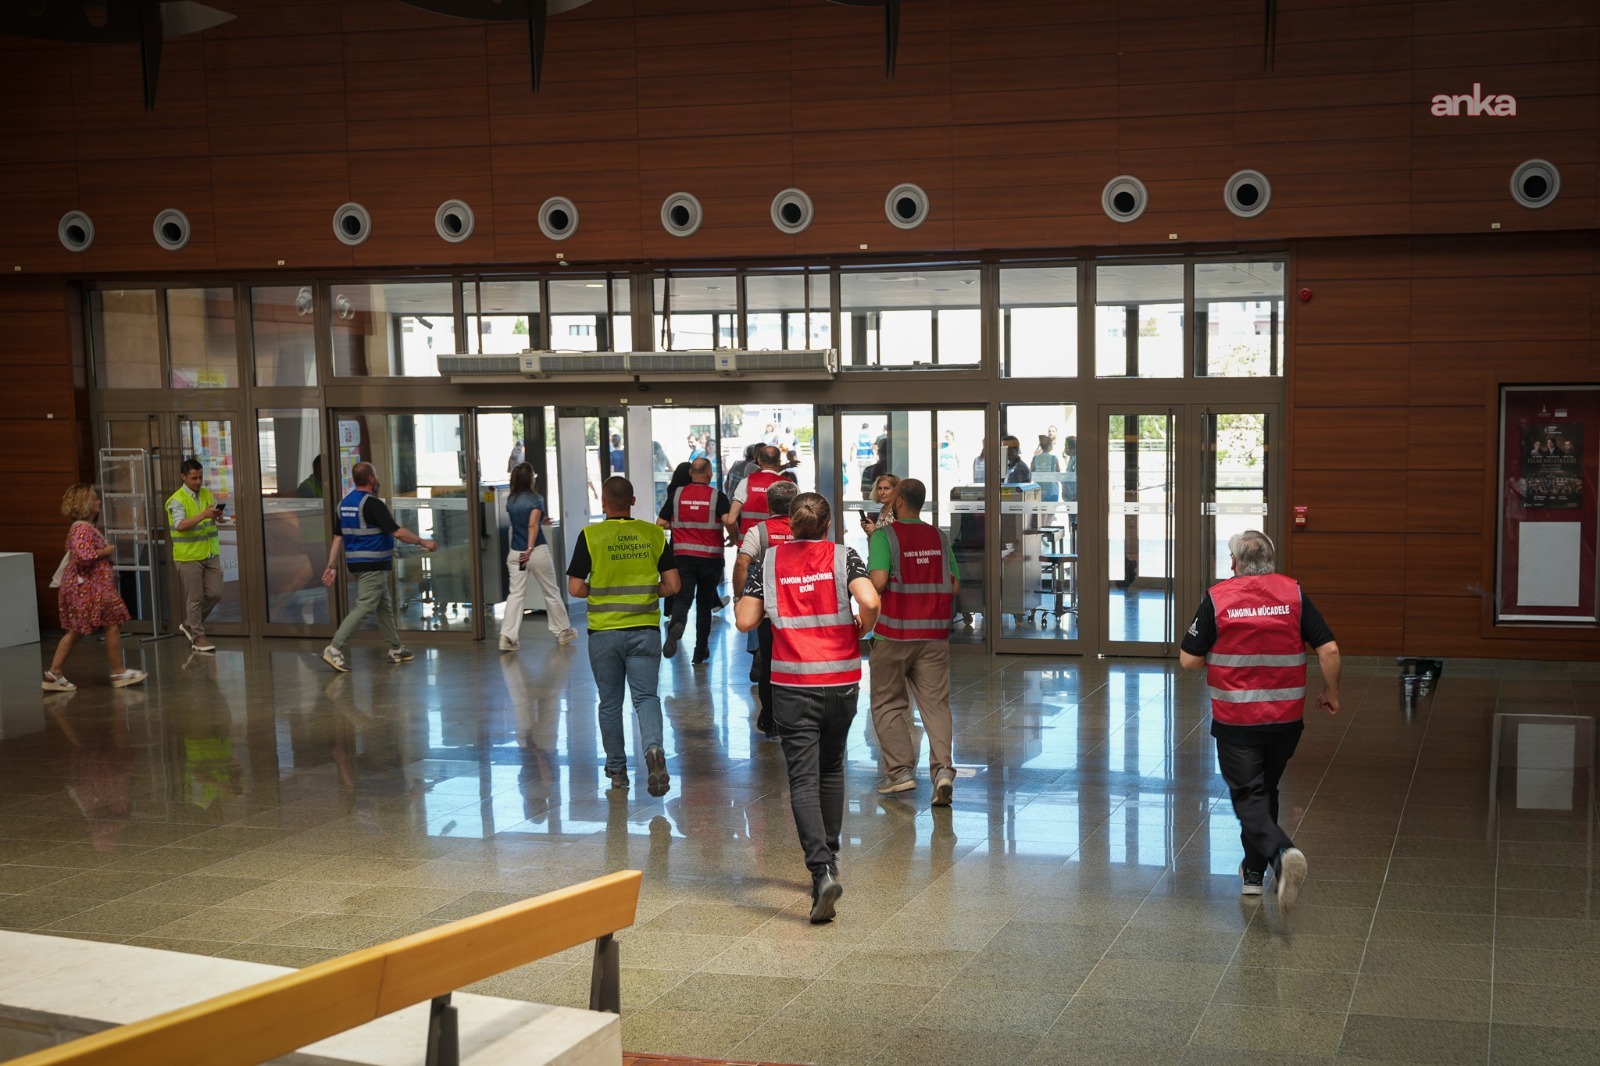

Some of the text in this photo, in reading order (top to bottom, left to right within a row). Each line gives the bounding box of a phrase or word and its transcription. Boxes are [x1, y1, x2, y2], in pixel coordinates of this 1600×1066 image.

[607, 543, 652, 551] BÜYÜKŞEHİR
[611, 551, 650, 561] BELEDİYESİ
[918, 549, 942, 557] SÖNDÜRME
[780, 572, 833, 585] YANGIN SÖNDÜRME
[799, 583, 815, 593] EKİBİ
[1227, 604, 1290, 618] YANGINLA MÜCADELE
